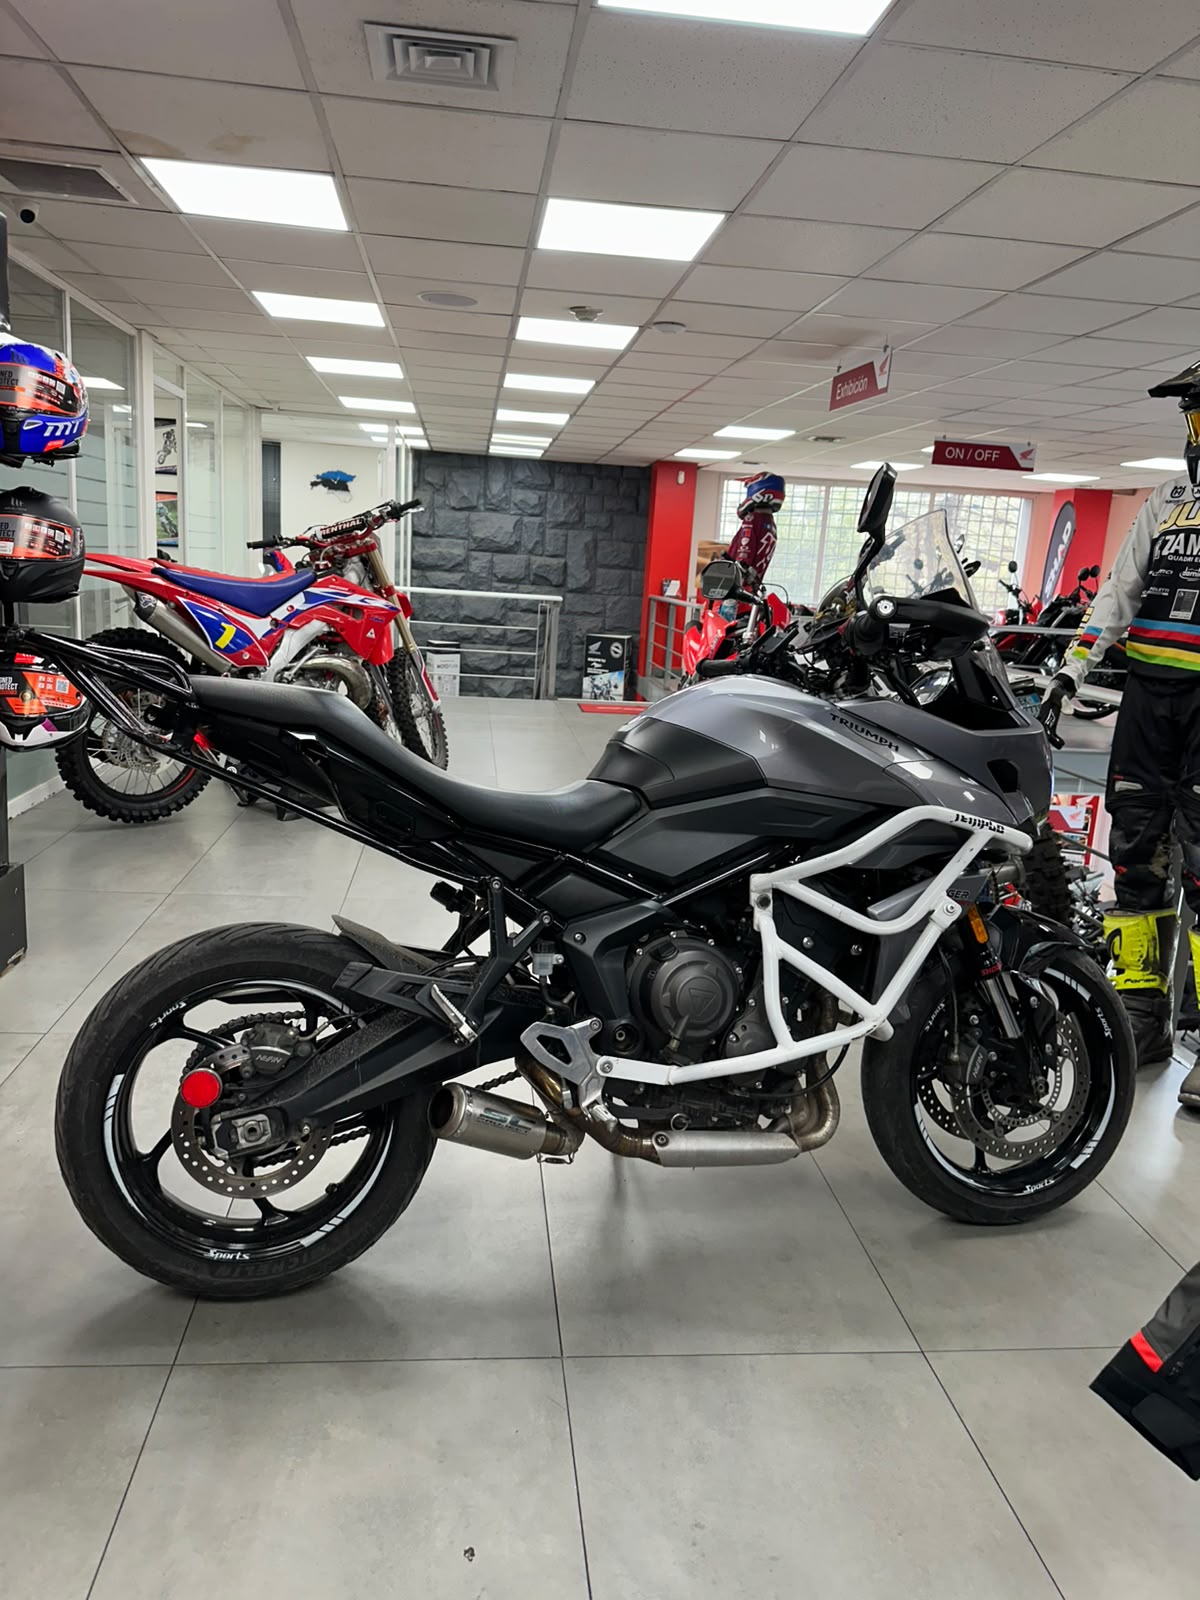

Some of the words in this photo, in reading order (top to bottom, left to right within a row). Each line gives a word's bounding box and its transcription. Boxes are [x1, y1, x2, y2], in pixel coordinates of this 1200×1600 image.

[836, 375, 868, 400] Exhibición
[945, 446, 965, 460] ON
[967, 449, 973, 460] /
[974, 449, 1001, 462] OFF
[215, 622, 237, 649] 1
[830, 712, 899, 752] TRIUMPH
[1095, 1007, 1113, 1039] Sports
[203, 1248, 251, 1260] Sports
